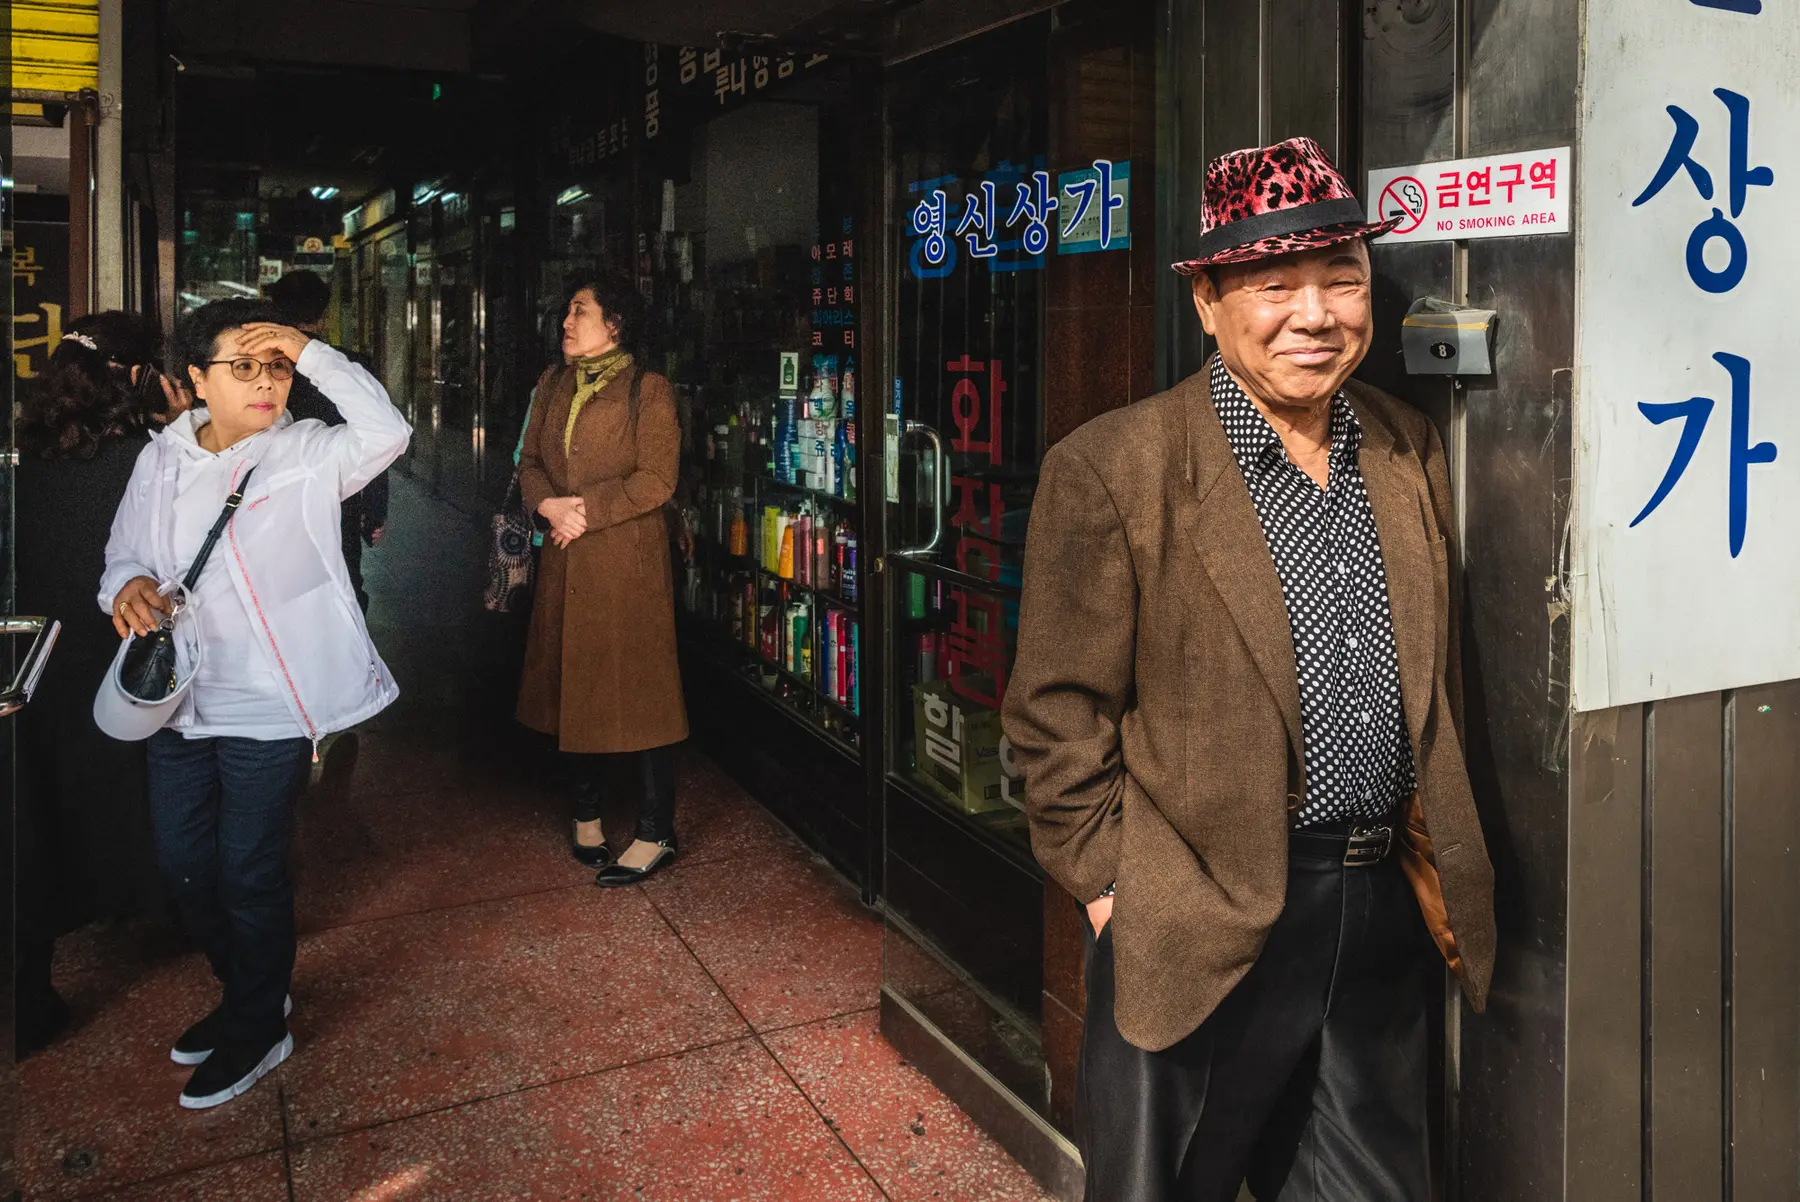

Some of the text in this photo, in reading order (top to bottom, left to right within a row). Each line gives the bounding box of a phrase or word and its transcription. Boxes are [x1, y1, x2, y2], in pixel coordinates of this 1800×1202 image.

[1436, 158, 1557, 210] 금연구역
[913, 159, 1125, 265] 영신상가
[1437, 212, 1557, 231] NO SMOKING AREA
[811, 239, 853, 262] 아모레
[1630, 0, 1778, 559] 상가
[811, 329, 855, 349] 코티
[1438, 344, 1448, 358] 8
[946, 354, 1008, 709] 화장품
